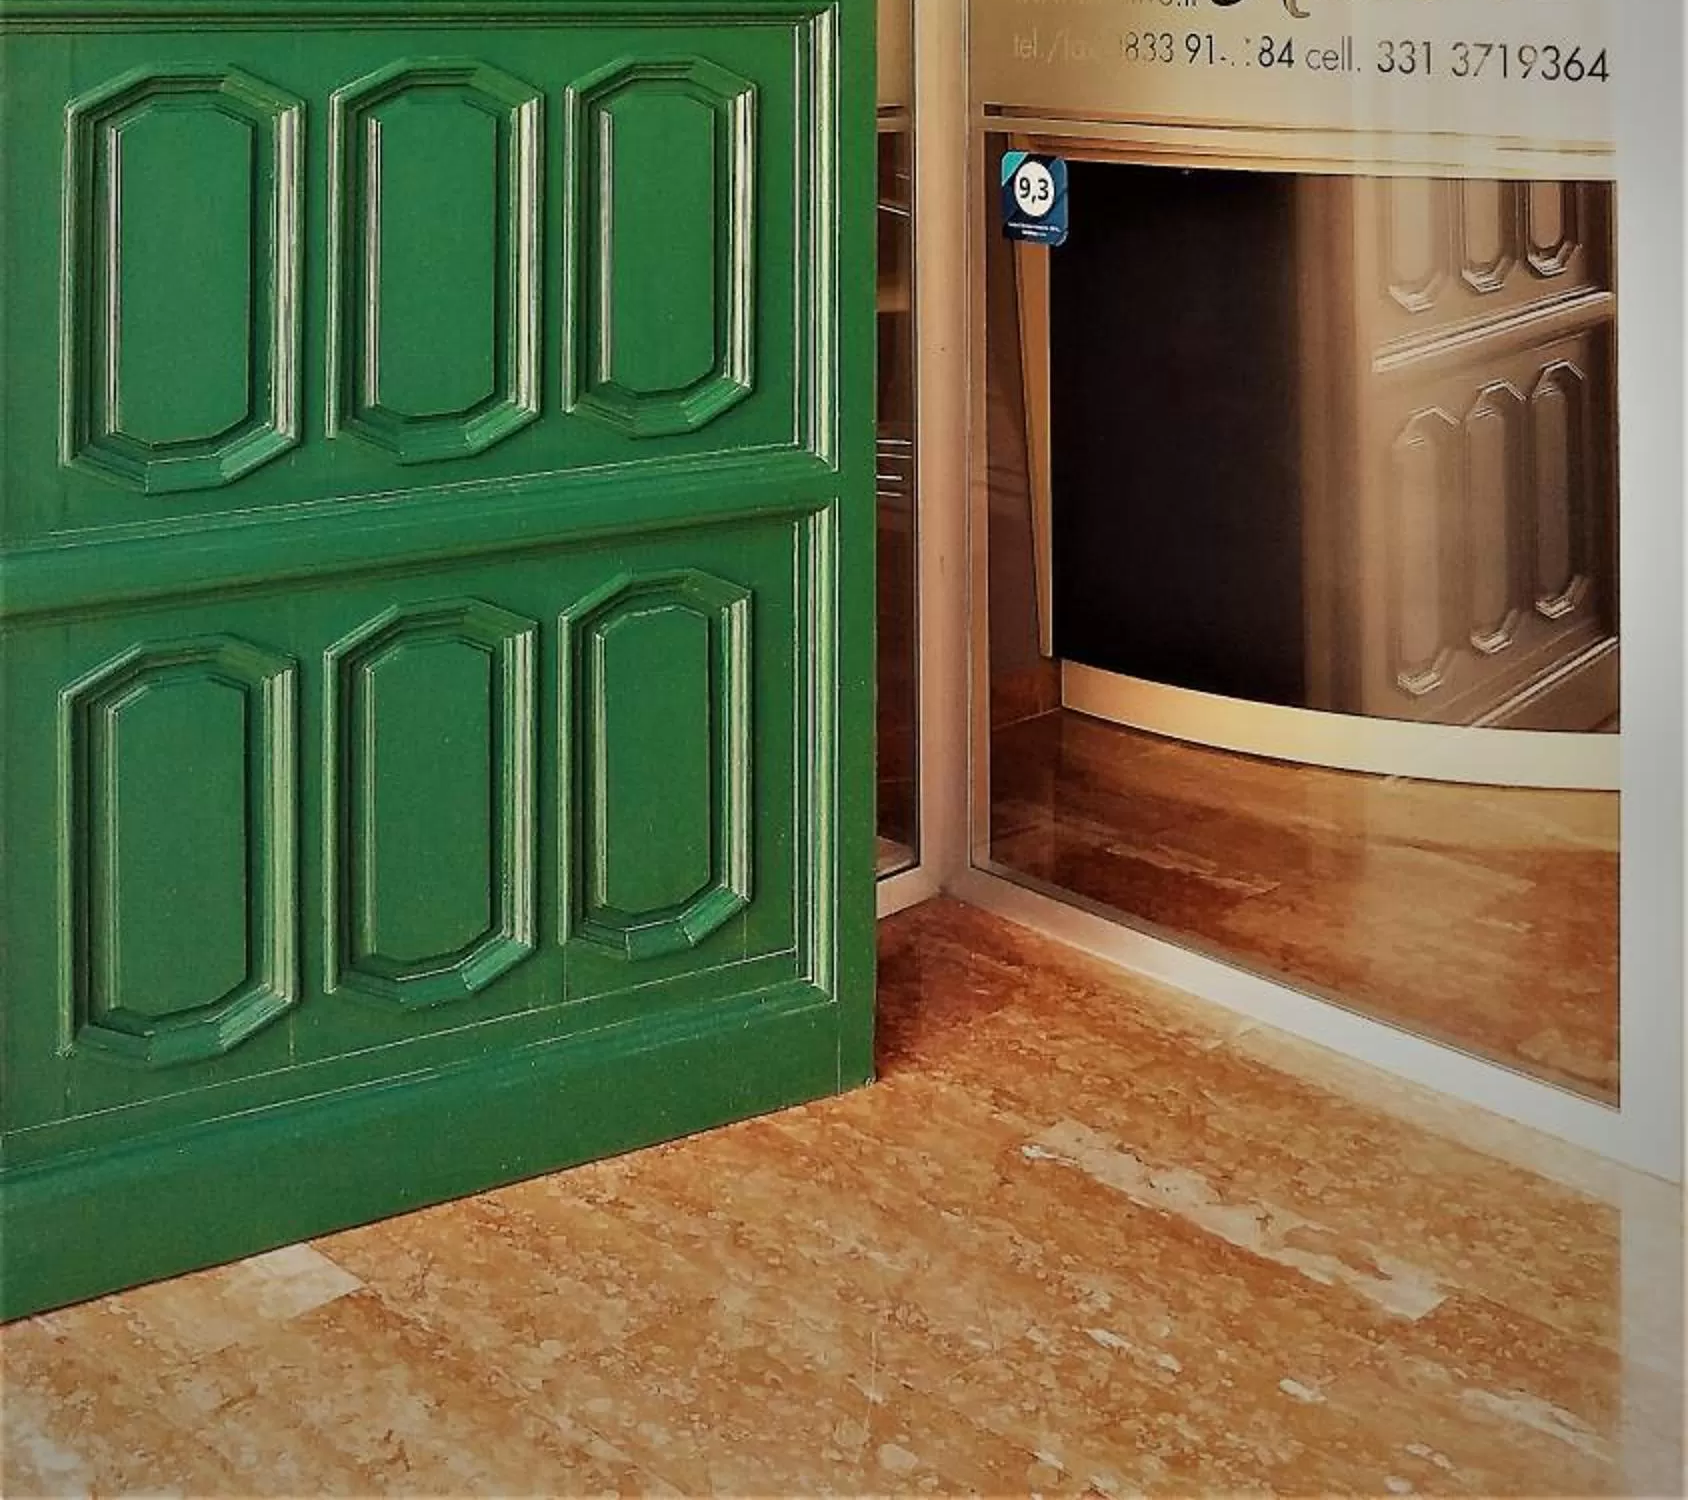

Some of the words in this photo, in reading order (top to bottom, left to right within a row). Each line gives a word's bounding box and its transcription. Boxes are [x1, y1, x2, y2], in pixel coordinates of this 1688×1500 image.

[1119, 31, 1175, 64] 833
[1305, 33, 1361, 72] cell.
[1376, 39, 1433, 77] 331
[1450, 40, 1611, 83] 3719364
[1019, 177, 1049, 204] 9,3
